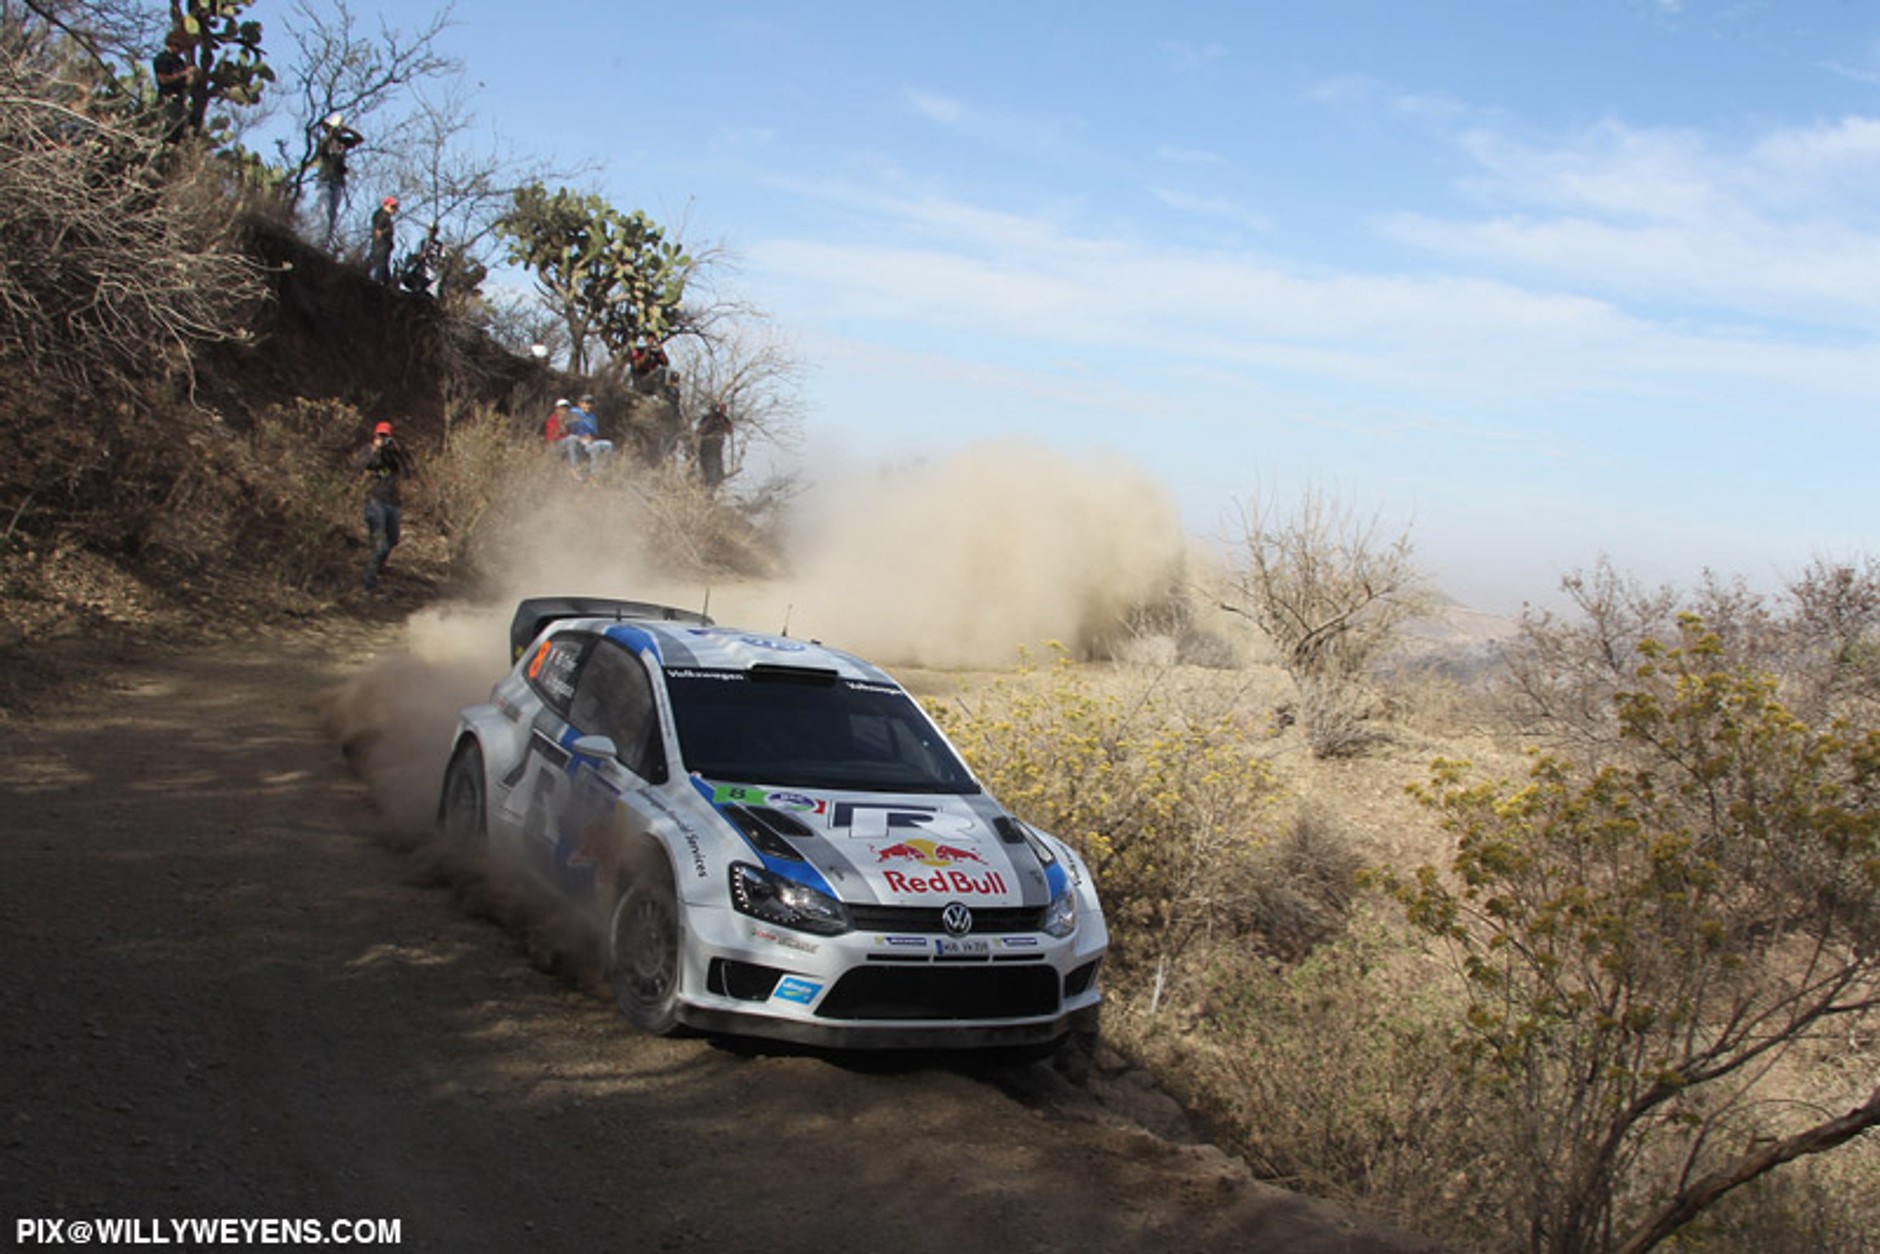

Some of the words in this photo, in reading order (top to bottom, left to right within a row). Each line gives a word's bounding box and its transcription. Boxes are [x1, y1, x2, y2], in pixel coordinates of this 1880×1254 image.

[667, 669, 744, 681] Volkswagen
[883, 869, 949, 894] Red
[949, 870, 1008, 895] Bull
